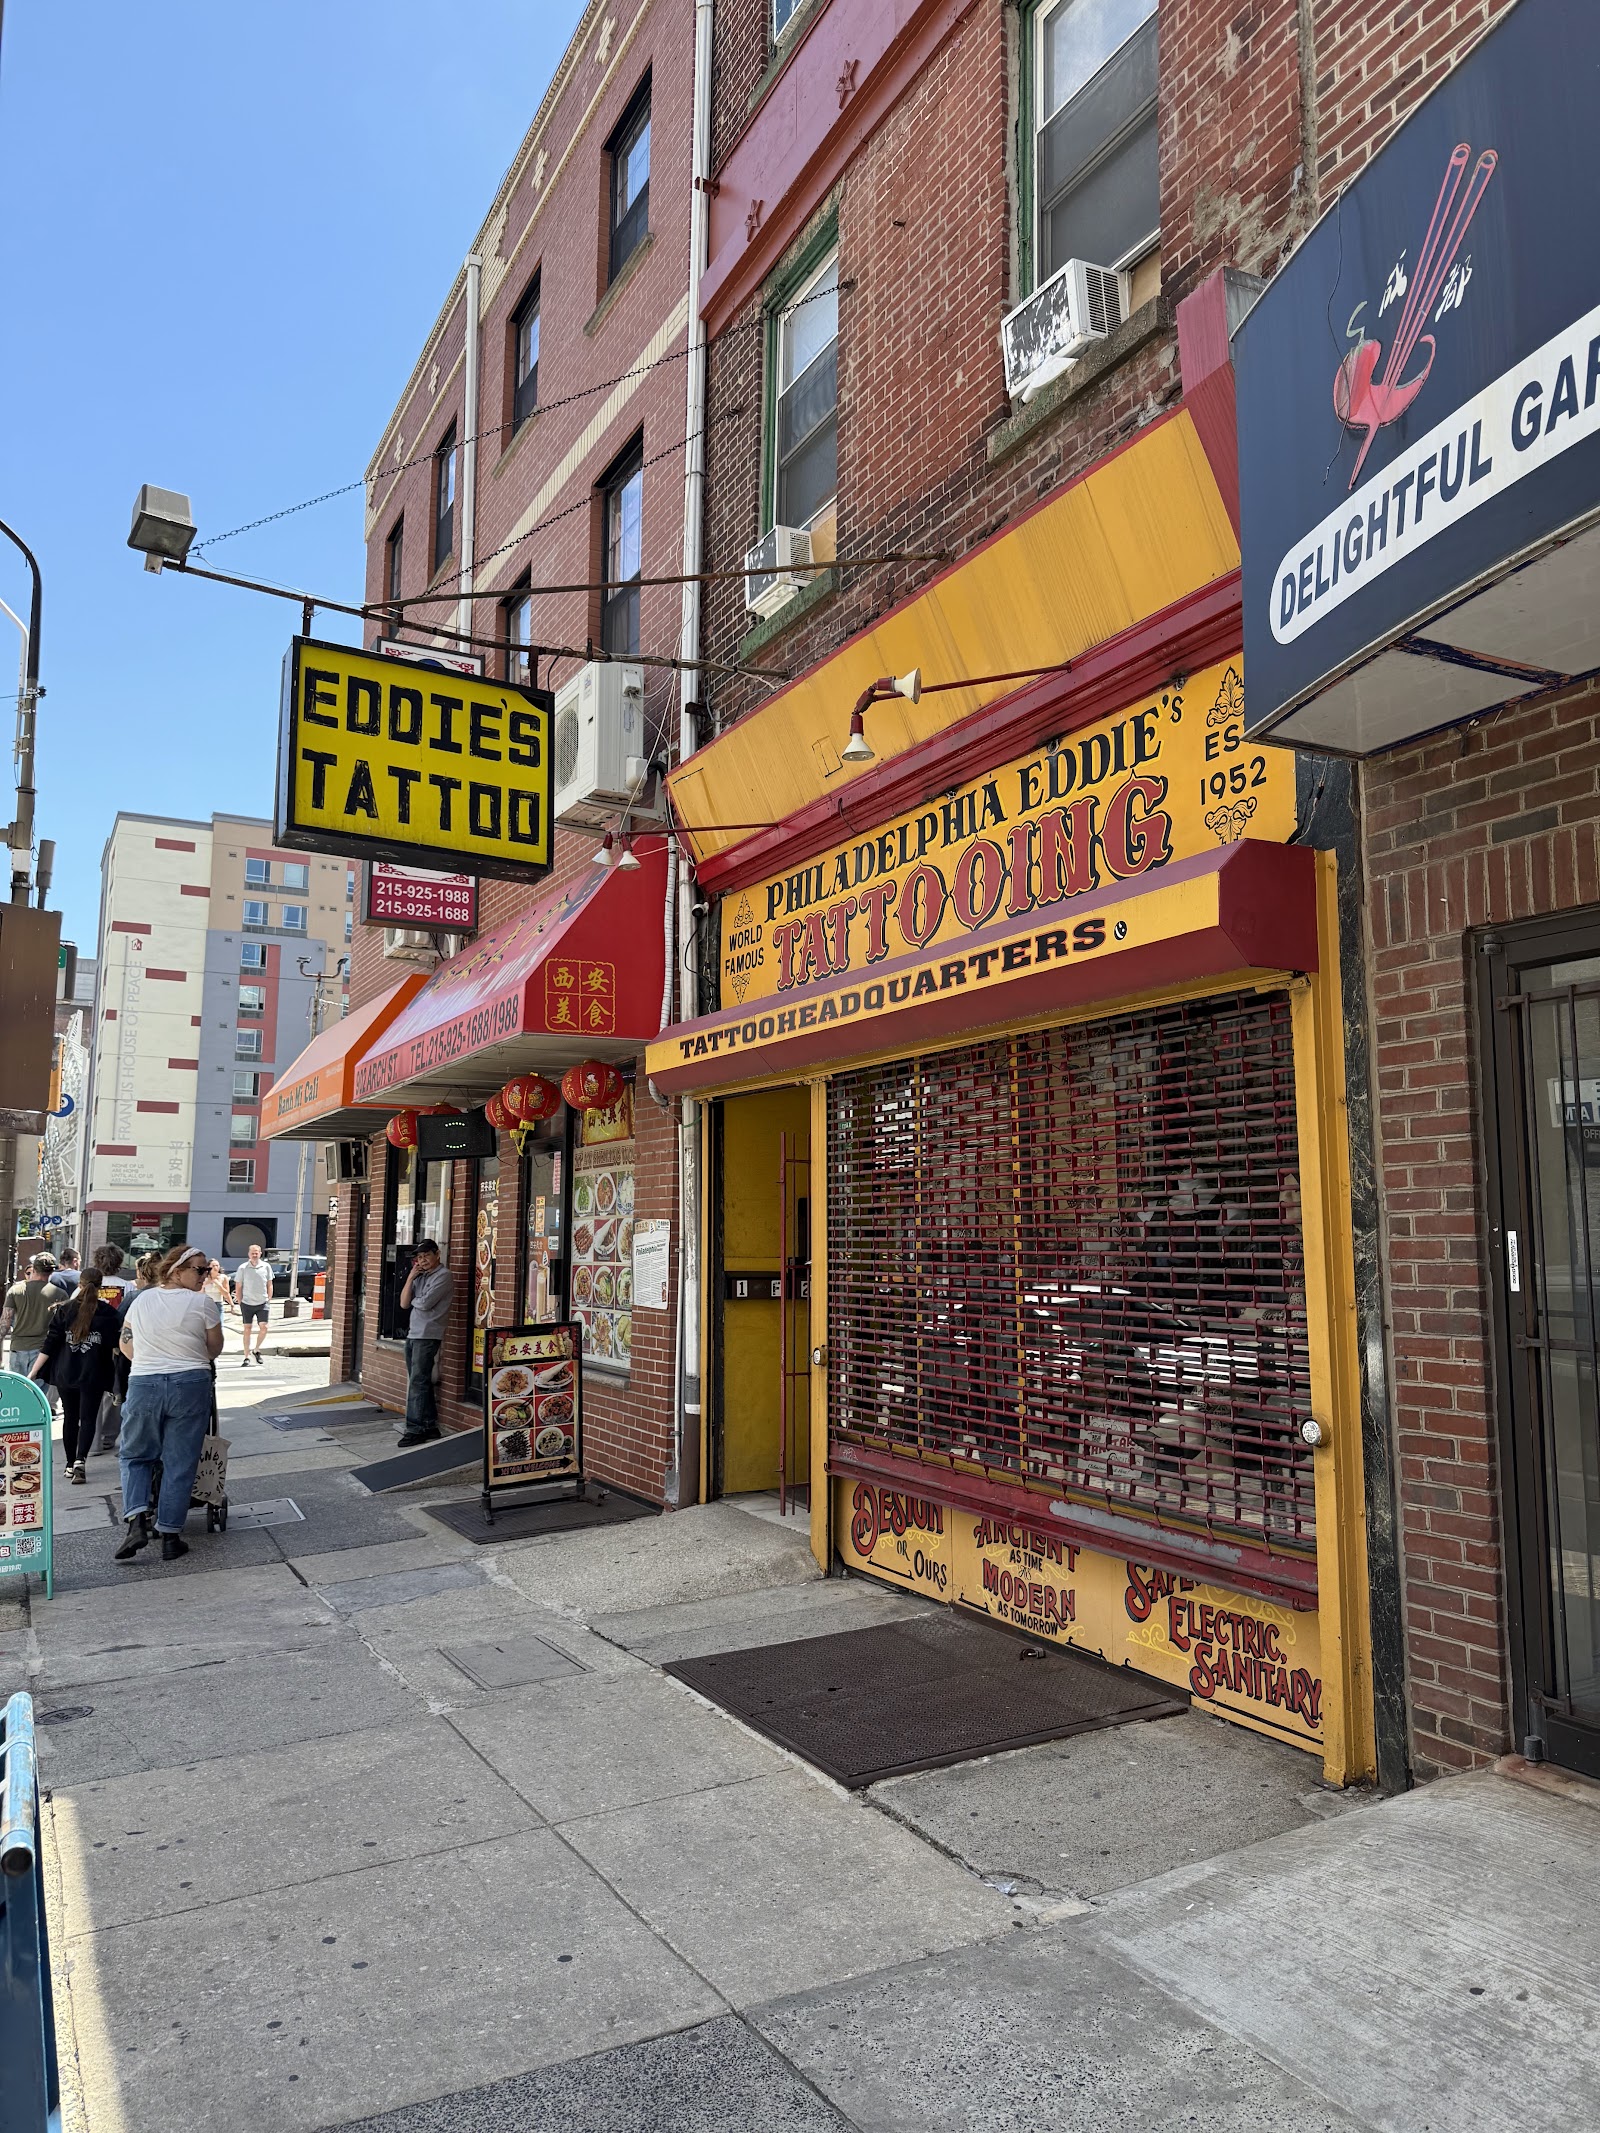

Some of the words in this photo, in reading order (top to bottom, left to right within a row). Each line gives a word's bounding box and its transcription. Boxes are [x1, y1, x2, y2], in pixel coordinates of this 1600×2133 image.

[1279, 420, 1493, 630] DELIGHTFUL
[303, 667, 541, 768] EDDIE'S
[1205, 724, 1242, 762] ES
[302, 748, 540, 846] TATTOO
[1200, 755, 1267, 806] 1952
[764, 778, 1008, 924] PHILADELPHIA
[1017, 693, 1187, 812] EDDIE'S
[376, 882, 470, 904] 215-925-1988
[772, 770, 1174, 993] TATTOOING
[376, 899, 470, 922] 215-925-1688
[728, 924, 763, 952] WORLD
[552, 966, 610, 993] 西安
[724, 947, 765, 978] FAMOUS
[127, 960, 142, 1004] PEACE
[126, 1005, 140, 1027] OF
[551, 996, 612, 1028] 美食
[122, 1029, 138, 1080] HOUSE
[366, 1060, 387, 1090] ARCH
[117, 1081, 134, 1141] FRANCIS
[1583, 1129, 1600, 1139] OFF
[739, 1281, 745, 1295] 1
[0, 1406, 20, 1417] an
[523, 1459, 562, 1473] WELCOME
[896, 1539, 910, 1561] OR
[974, 1517, 1080, 1573] ANCIENT
[1009, 1549, 1022, 1564] AS
[1023, 1552, 1043, 1573] TIME
[914, 1549, 947, 1592] OURS
[982, 1558, 1076, 1630] MODERN
[997, 1600, 1009, 1617] AS
[1010, 1606, 1059, 1636] TOMORROW
[1168, 1596, 1288, 1665] ELECTRIC,
